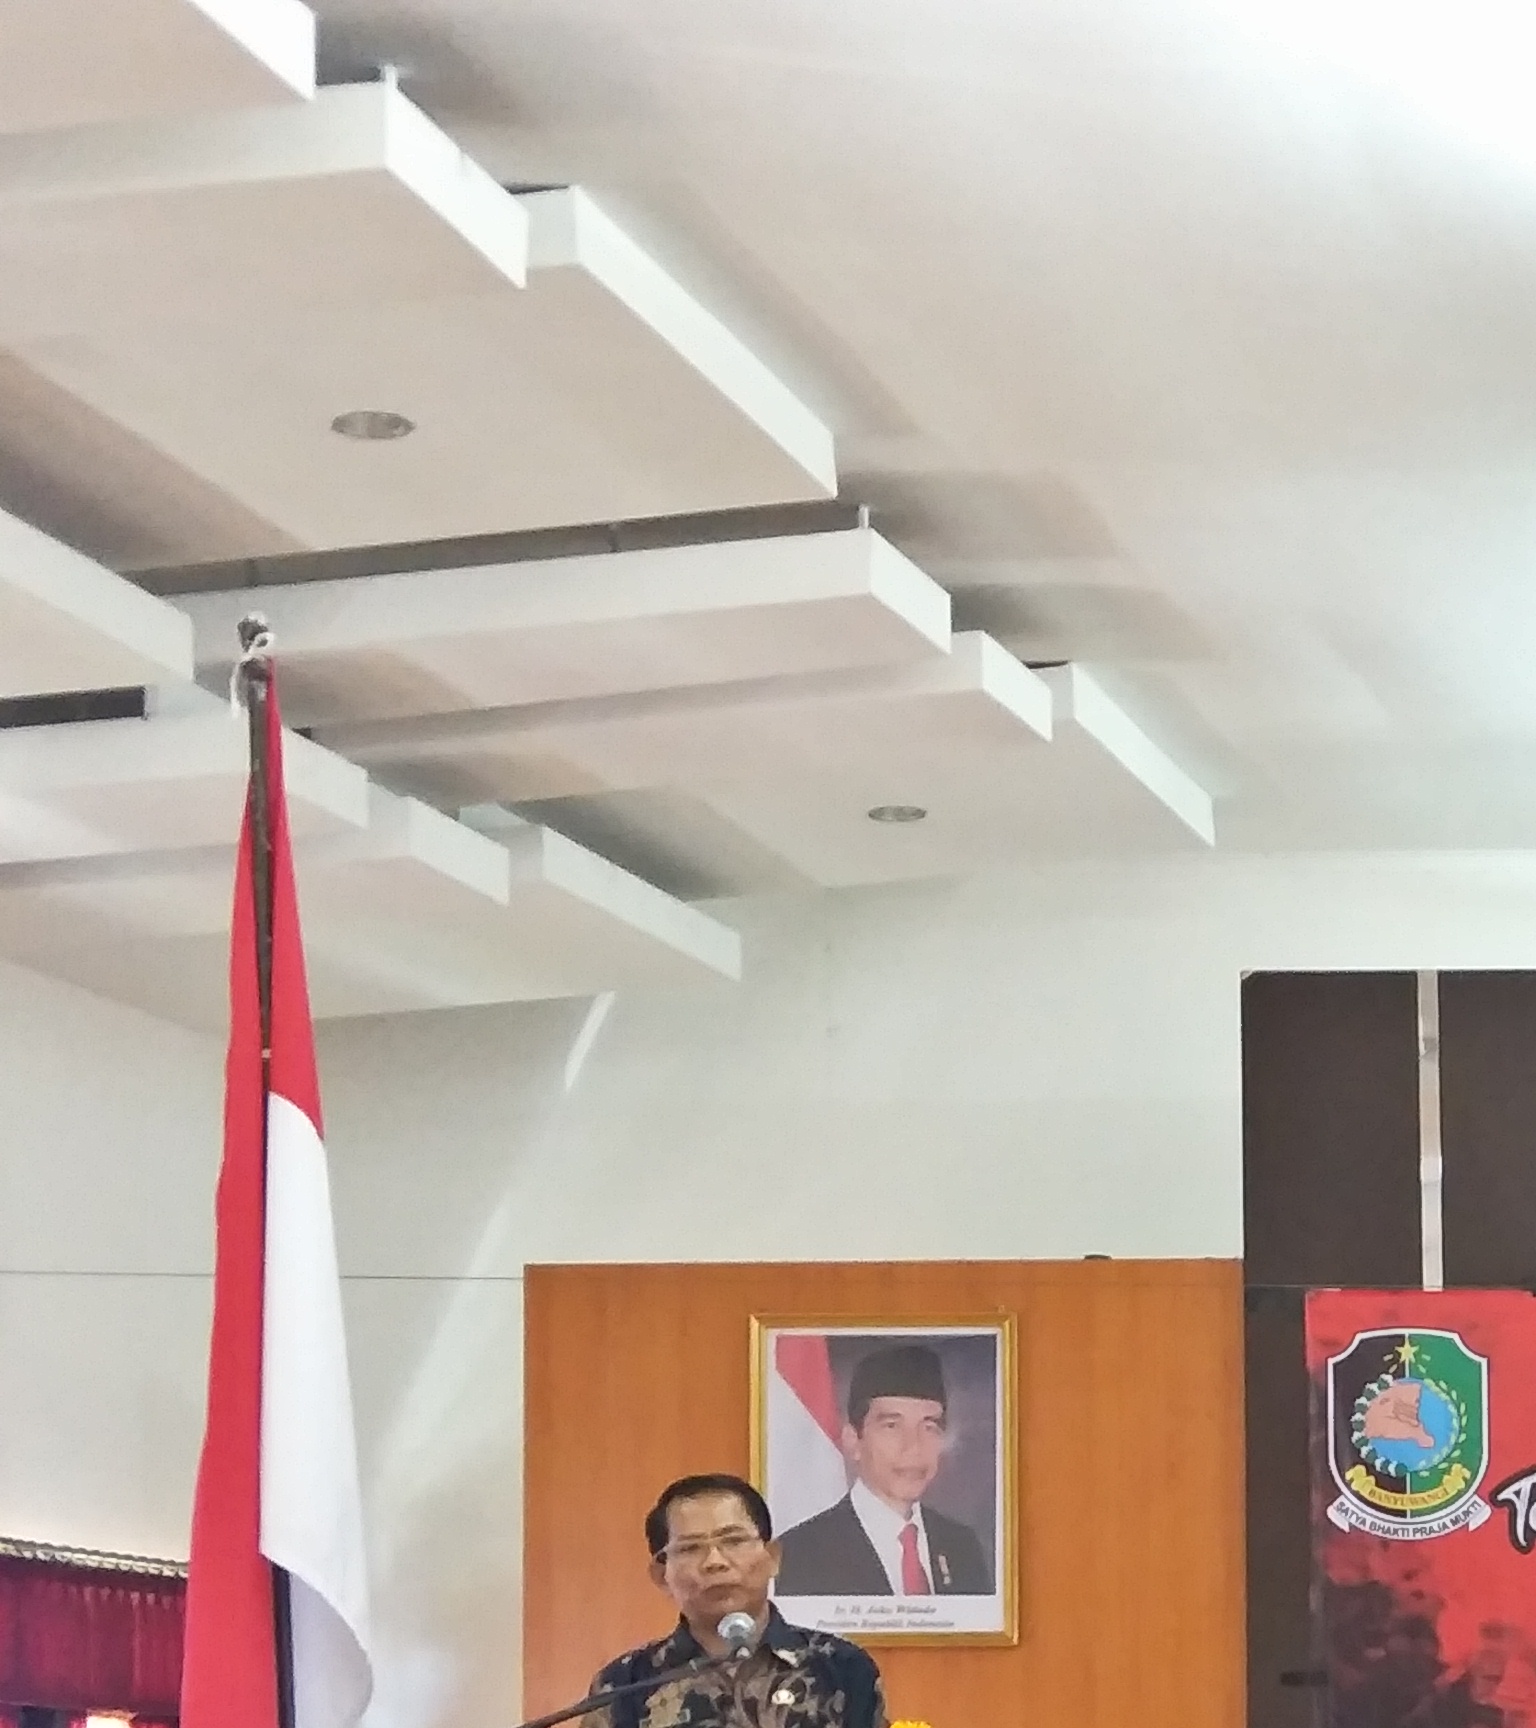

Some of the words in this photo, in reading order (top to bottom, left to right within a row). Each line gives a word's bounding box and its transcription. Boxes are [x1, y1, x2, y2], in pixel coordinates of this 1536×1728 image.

[1335, 1501, 1367, 1528] SATYA
[1369, 1523, 1410, 1538] BHAKTI
[1413, 1522, 1449, 1538] PRAJA
[1451, 1501, 1482, 1527] MUKTI
